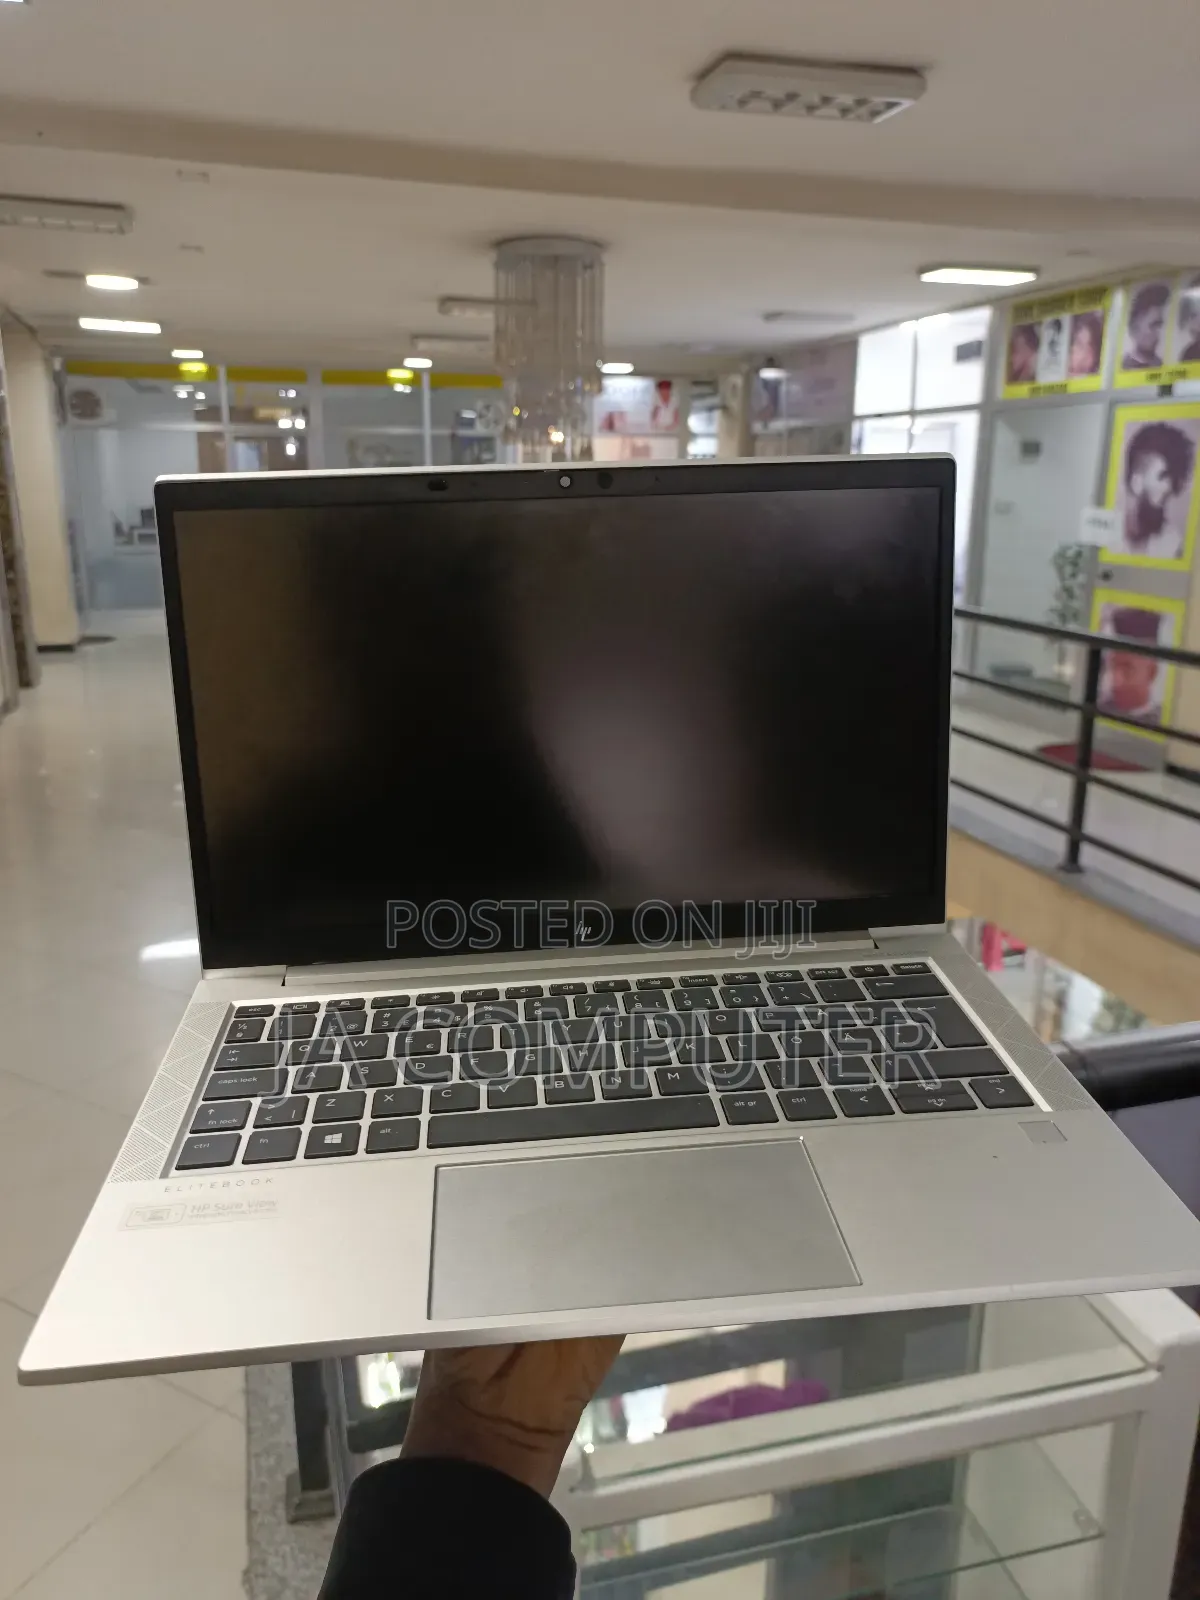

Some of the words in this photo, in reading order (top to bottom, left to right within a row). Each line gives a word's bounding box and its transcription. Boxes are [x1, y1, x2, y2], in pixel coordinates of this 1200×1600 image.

[575, 920, 592, 941] hp
[613, 1020, 623, 1028] U
[509, 1028, 517, 1036] T
[298, 1044, 311, 1052] Q
[685, 1042, 696, 1051] K
[578, 1049, 589, 1057] H
[470, 1057, 480, 1065] F
[360, 1066, 369, 1074] S
[415, 1062, 426, 1070] D
[305, 1071, 316, 1079] A
[667, 1072, 680, 1080] M
[218, 1077, 238, 1085] caps
[610, 1076, 622, 1084] N
[498, 1084, 510, 1093] V
[554, 1080, 565, 1089] B
[441, 1089, 452, 1097] C
[383, 1093, 394, 1102] X
[325, 1098, 337, 1107] Z
[164, 1177, 273, 1193] ELITEBOOK
[190, 1203, 211, 1213] HP
